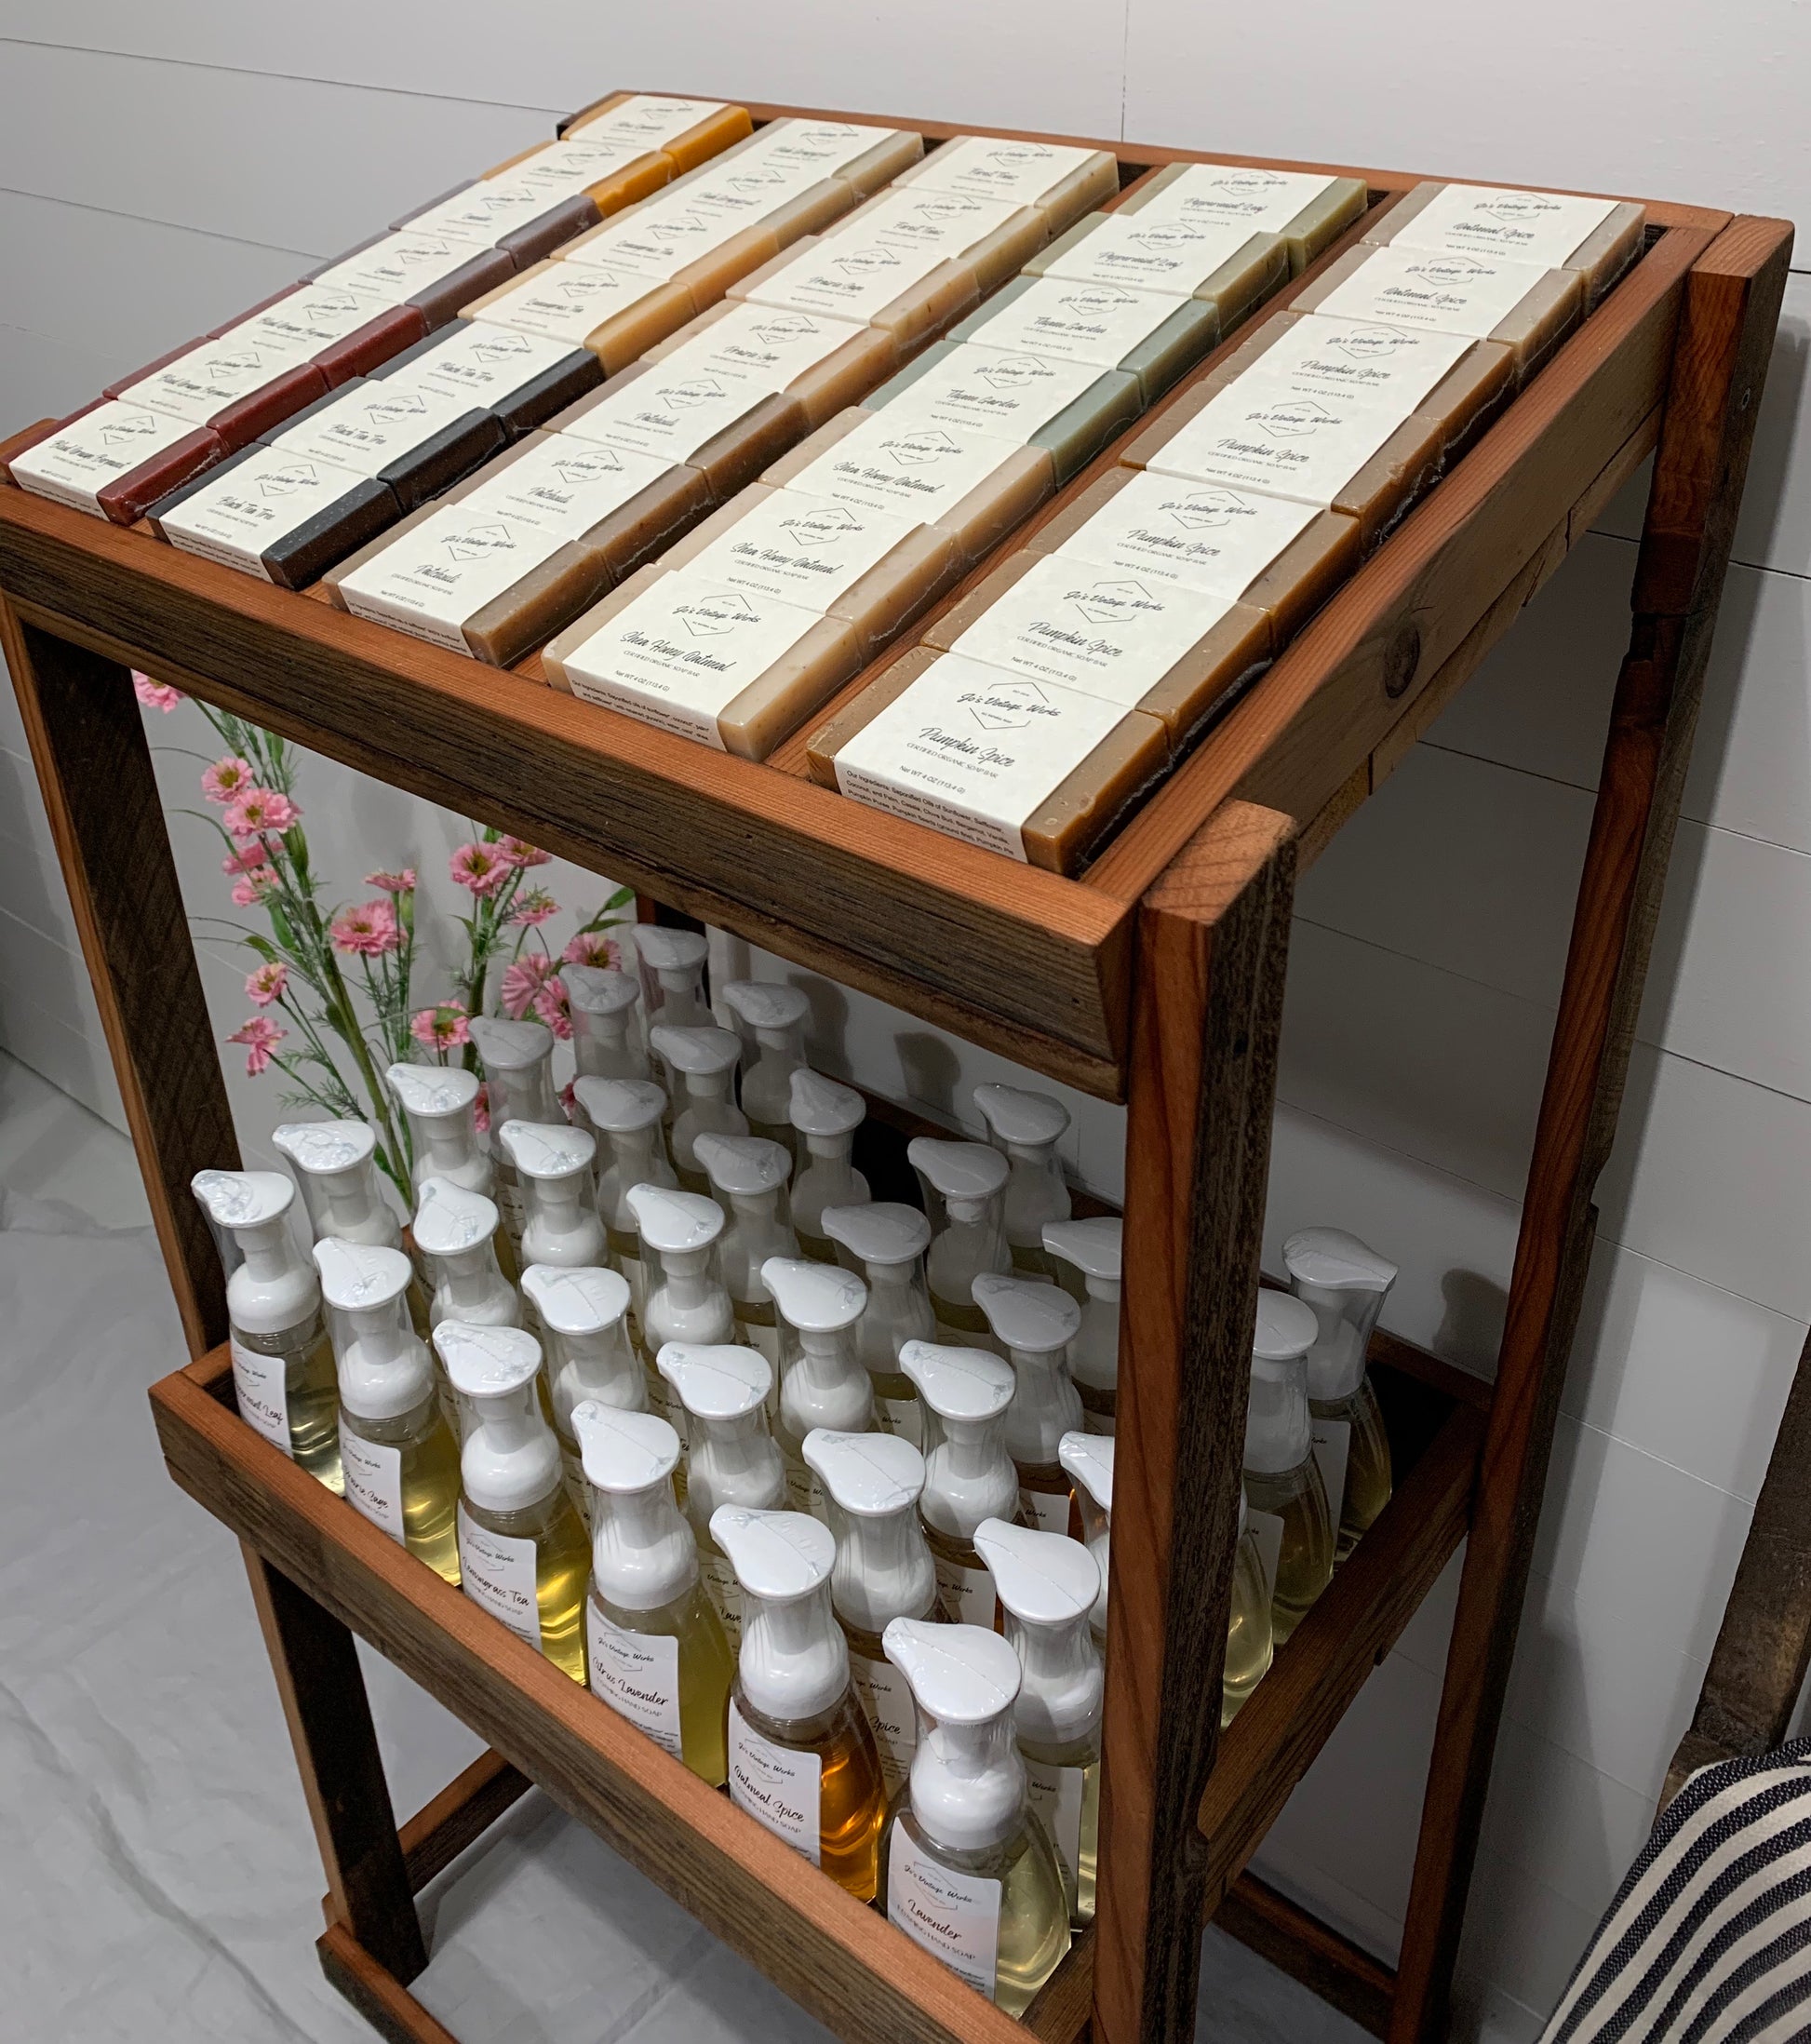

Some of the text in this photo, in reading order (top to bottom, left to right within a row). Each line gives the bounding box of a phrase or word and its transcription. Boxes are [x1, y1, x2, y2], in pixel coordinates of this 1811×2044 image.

[1383, 288, 1468, 305] Oatmeal Spice
[1301, 359, 1392, 380] Pumpkin Spice
[1217, 438, 1310, 464] Pumpkin Spice
[832, 462, 946, 494] Shea Honey Oatmeal
[1128, 529, 1221, 558] Pumpkin Spice
[731, 543, 844, 574] Shea Honey Oatmeal
[413, 564, 462, 584] Patchouli
[1063, 591, 1165, 612] Jo's Vintage Works
[672, 606, 761, 623] Jo's Vintage Works
[1029, 621, 1123, 657] Pumpkin Spice
[620, 631, 737, 672] Shea Honey Oatmeal
[957, 693, 1062, 717] Jo's Vintage Works
[920, 727, 1015, 767] Pumpkin Spice
[509, 1589, 530, 1607] Tea
[951, 1584, 973, 1594] Works
[632, 1652, 655, 1662] Works
[618, 1678, 669, 1706] Lavender
[869, 1682, 892, 1692] Works
[869, 1715, 901, 1735] Spice
[772, 1766, 796, 1777] Works
[734, 1765, 805, 1822] Oatmeal Spice
[919, 1875, 944, 1893] Vintage
[946, 1891, 973, 1903] Works
[907, 1899, 962, 1941] Lavender
